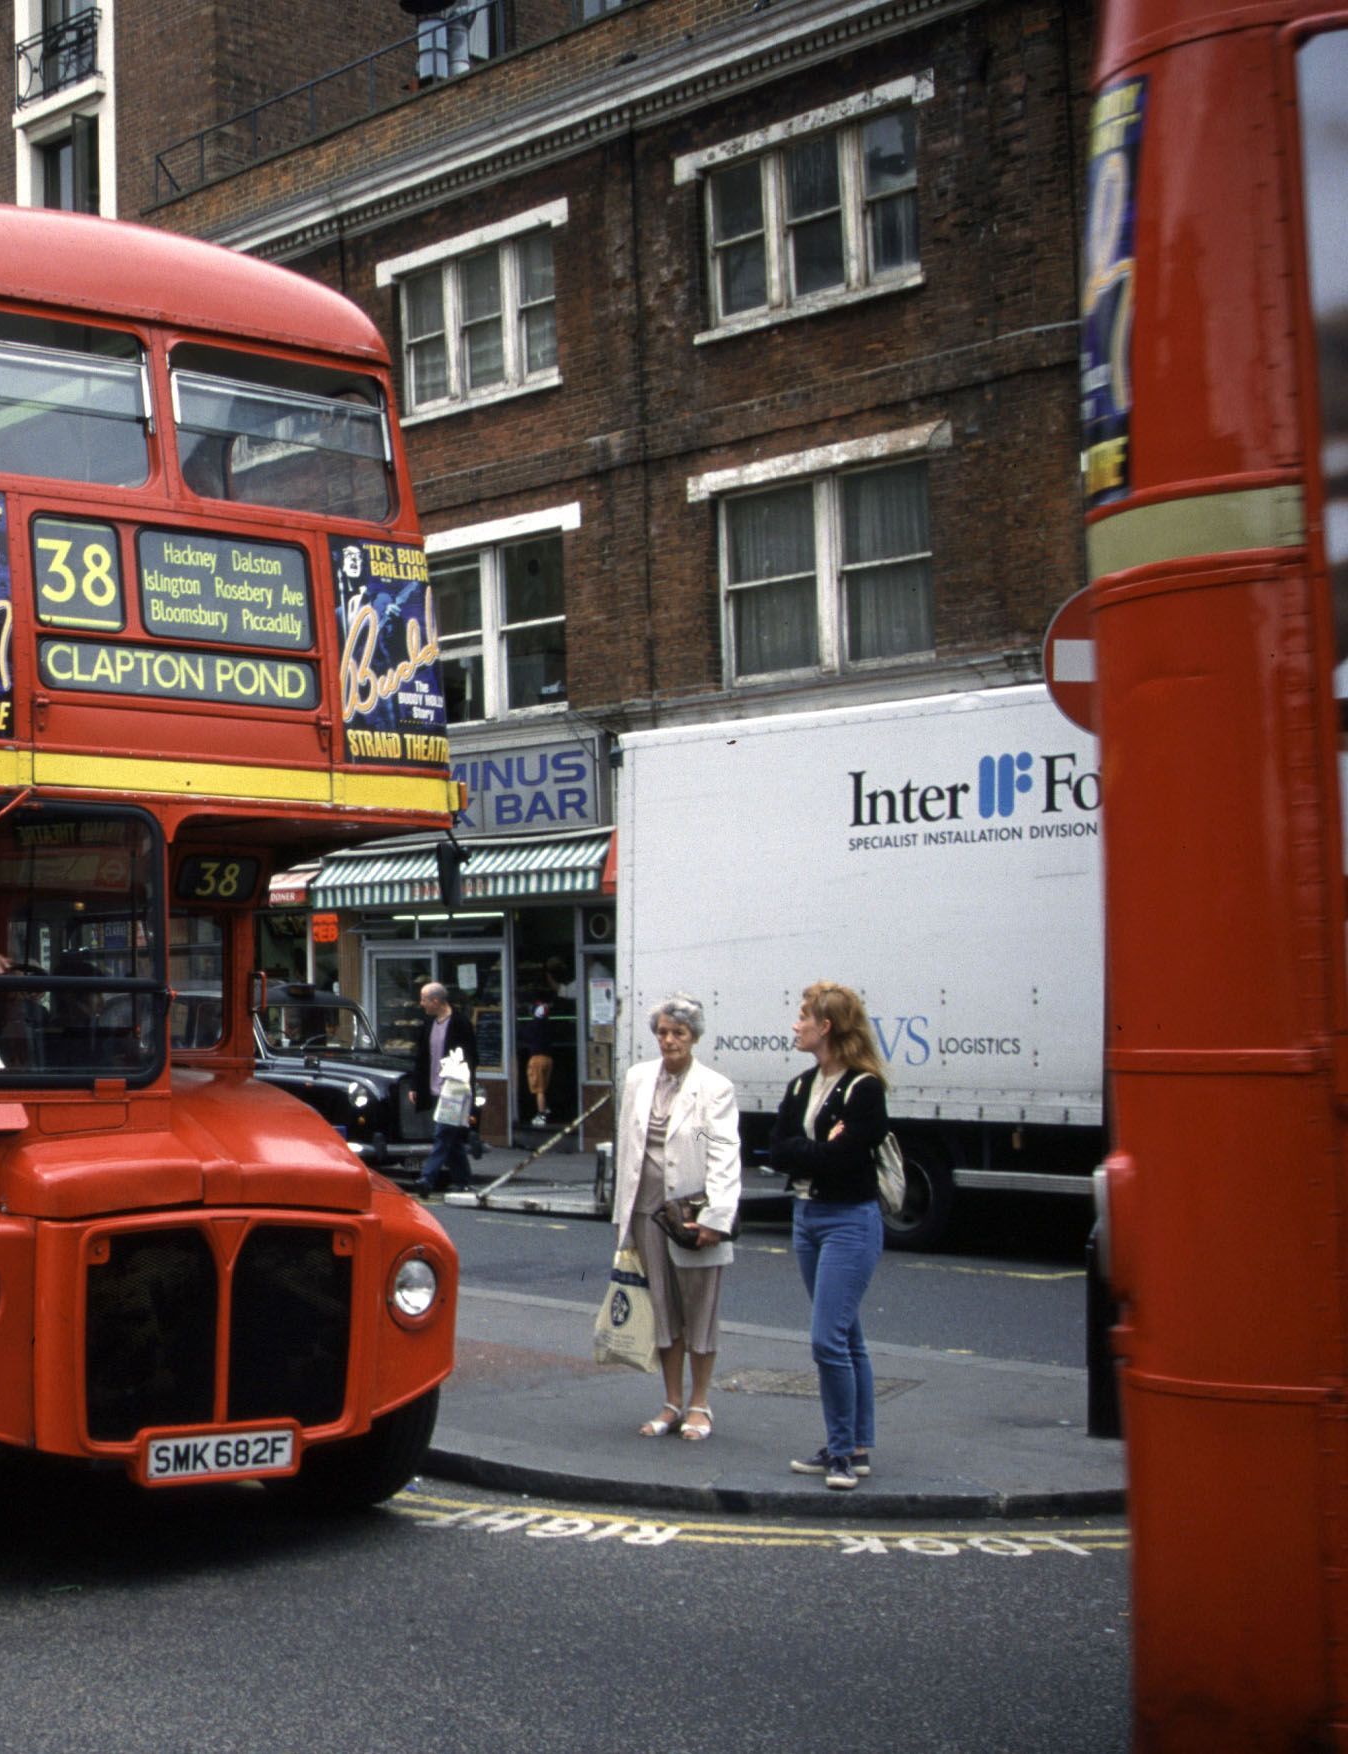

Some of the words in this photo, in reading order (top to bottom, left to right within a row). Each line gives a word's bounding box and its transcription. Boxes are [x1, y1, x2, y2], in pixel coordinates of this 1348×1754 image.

[37, 537, 117, 607] 38
[163, 541, 217, 574] Hackney
[232, 550, 282, 575] Dalston
[143, 569, 201, 600] Islington
[215, 576, 273, 609] Rosebery
[282, 583, 304, 607] Ave
[151, 598, 228, 634] Bloomsbury
[242, 607, 302, 641] Piccadilly
[46, 644, 204, 690] CLAPTON
[215, 658, 307, 699] POND
[346, 729, 402, 759] STRAND
[495, 788, 588, 825] BAR
[848, 770, 971, 827] Inter
[849, 833, 919, 851] SPECIALIST
[924, 827, 1022, 846] INSTALLATION
[1030, 821, 1099, 839] DIVISION
[195, 861, 241, 896] 38
[938, 1037, 1021, 1056] LOGISTICS
[154, 1442, 211, 1473] SMK
[213, 1436, 288, 1468] 682F
[415, 1509, 682, 1546] RIGHT
[834, 1534, 1093, 1557] LOOK
